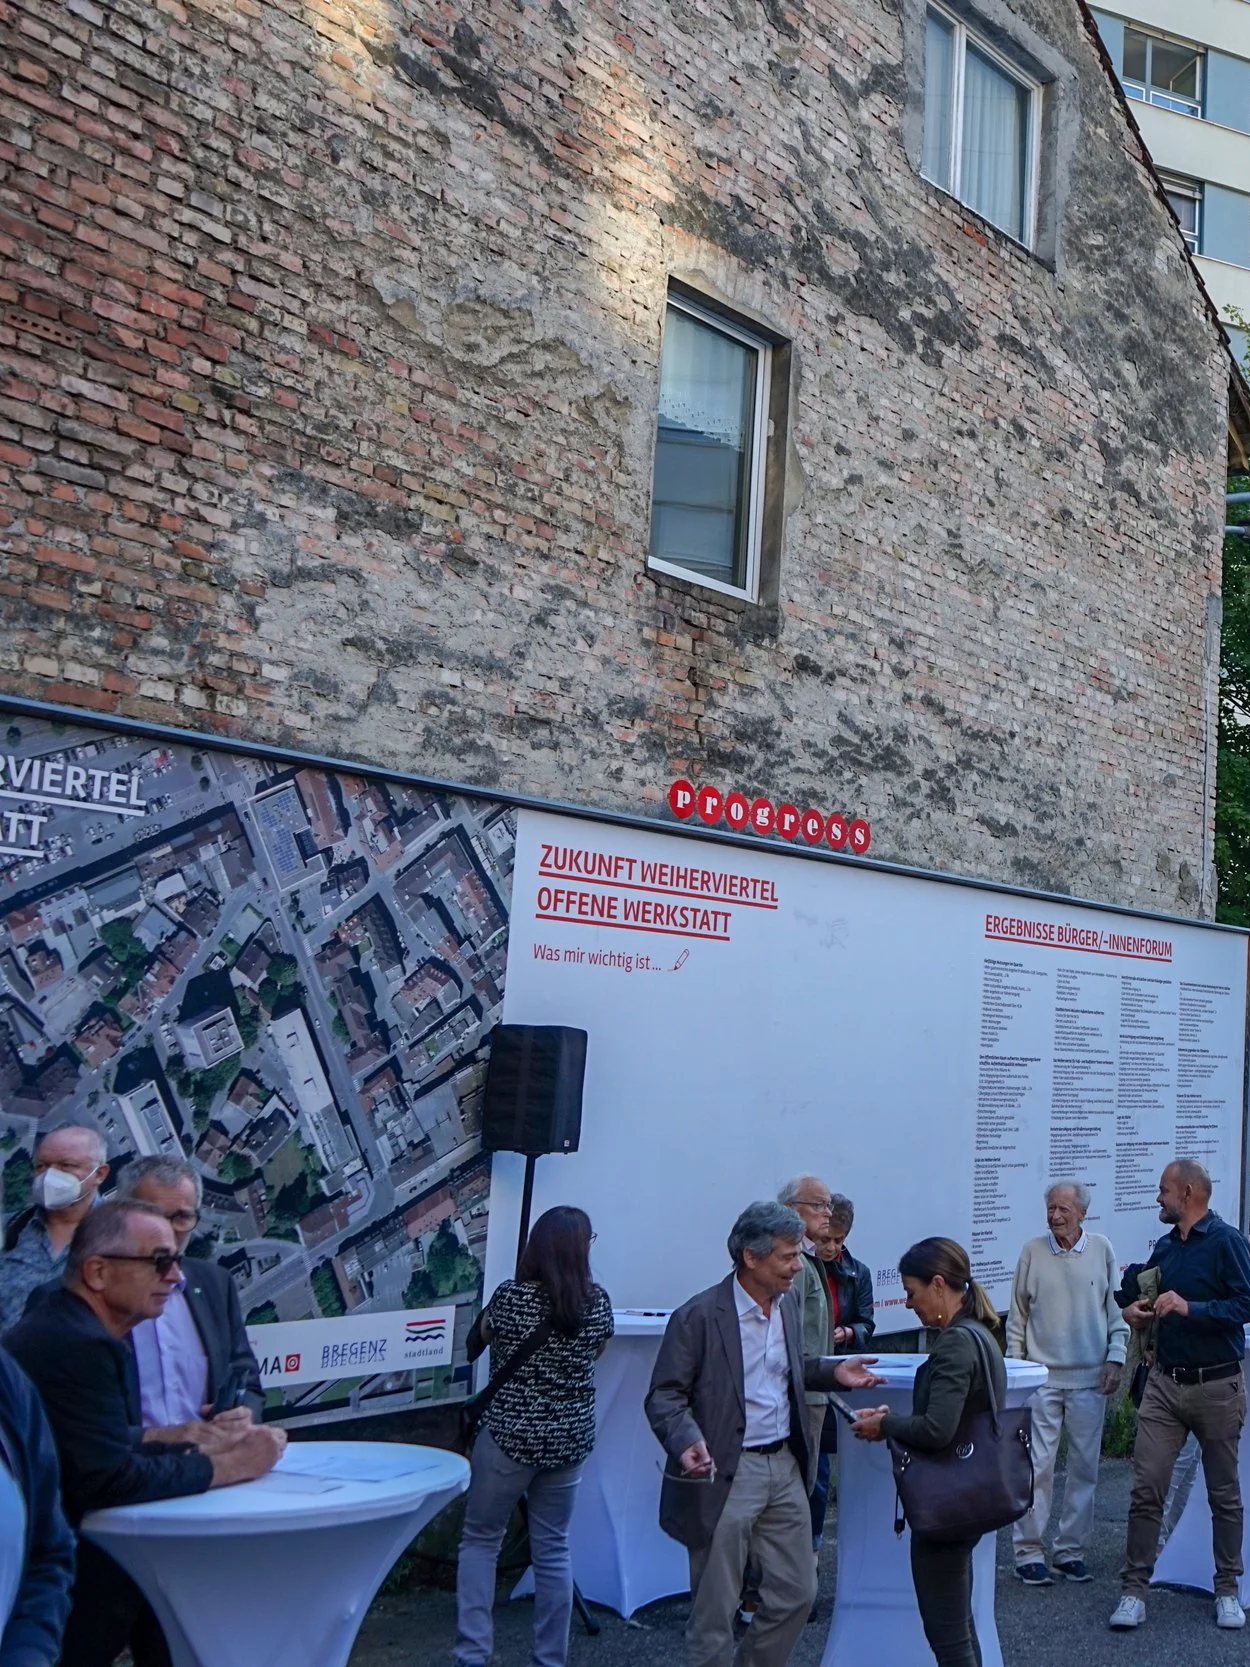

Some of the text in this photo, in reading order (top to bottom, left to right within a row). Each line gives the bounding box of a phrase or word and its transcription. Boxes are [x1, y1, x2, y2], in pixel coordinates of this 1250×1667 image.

[0, 755, 147, 806] VIERTEL
[676, 788, 866, 847] progress
[540, 844, 778, 902] ZUKUNFT WEIHERVIERTEL
[537, 886, 731, 933] OFFENE WERKSTATT
[985, 914, 1055, 942] ERGEBNISSE
[533, 943, 561, 962] Was
[563, 946, 586, 964] mir
[588, 949, 633, 973] wichtig
[322, 1338, 387, 1362] BREGENZ
[404, 1346, 444, 1359] stadtland
